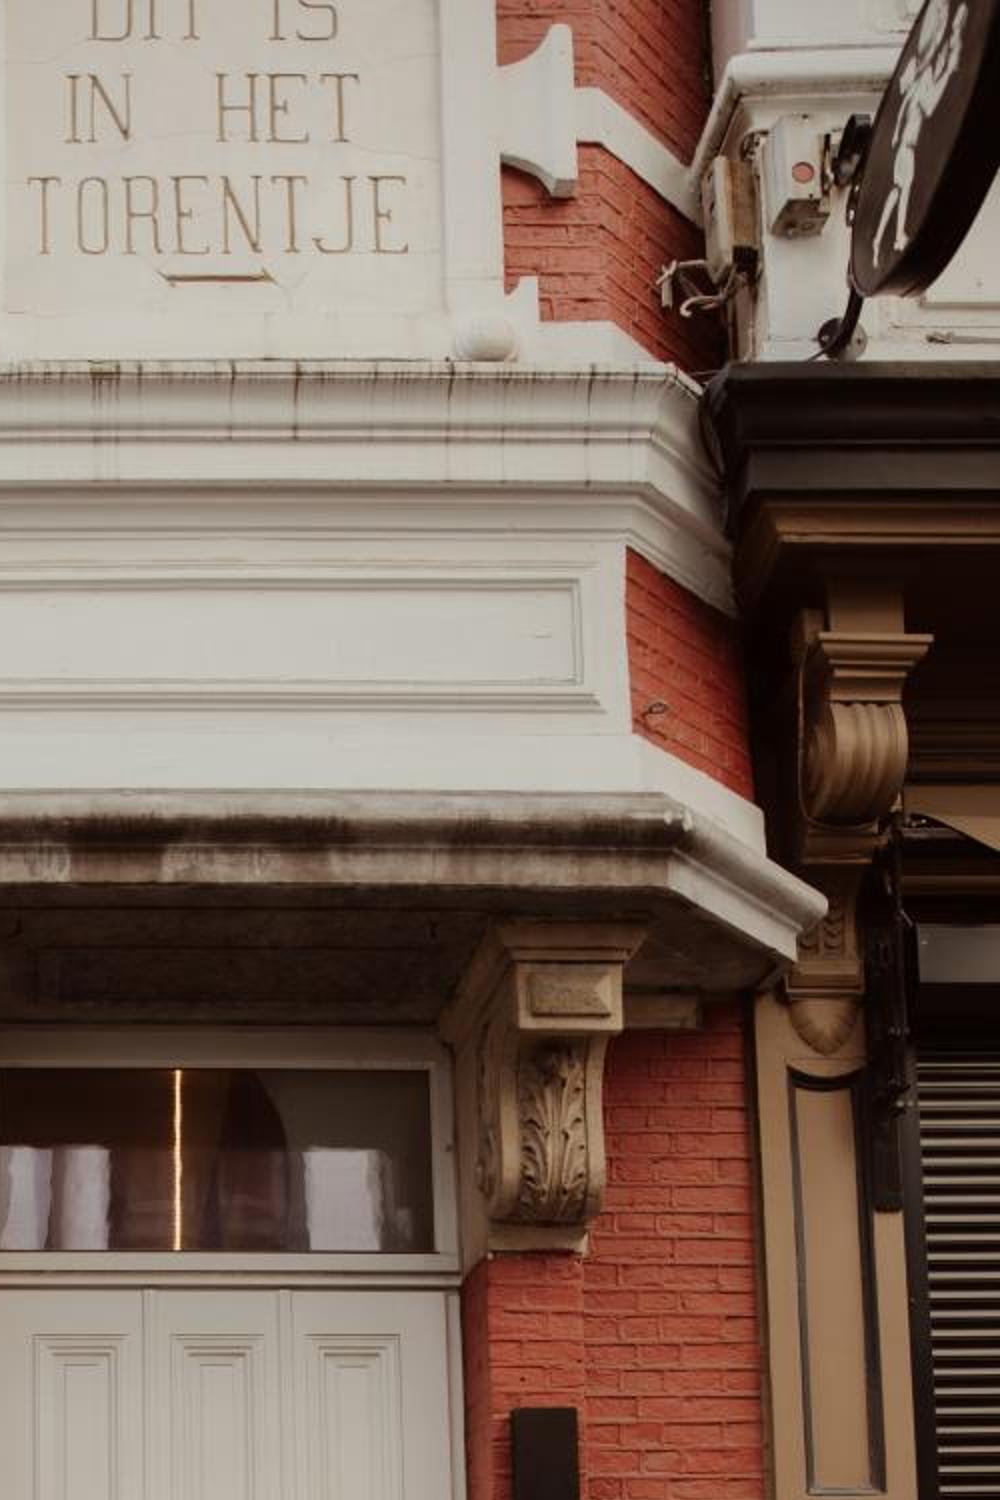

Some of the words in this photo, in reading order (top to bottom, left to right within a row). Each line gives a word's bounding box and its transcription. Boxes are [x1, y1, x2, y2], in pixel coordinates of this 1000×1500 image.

[64, 73, 134, 144] IN
[215, 73, 359, 144] HET
[27, 175, 409, 256] TORENTJE
